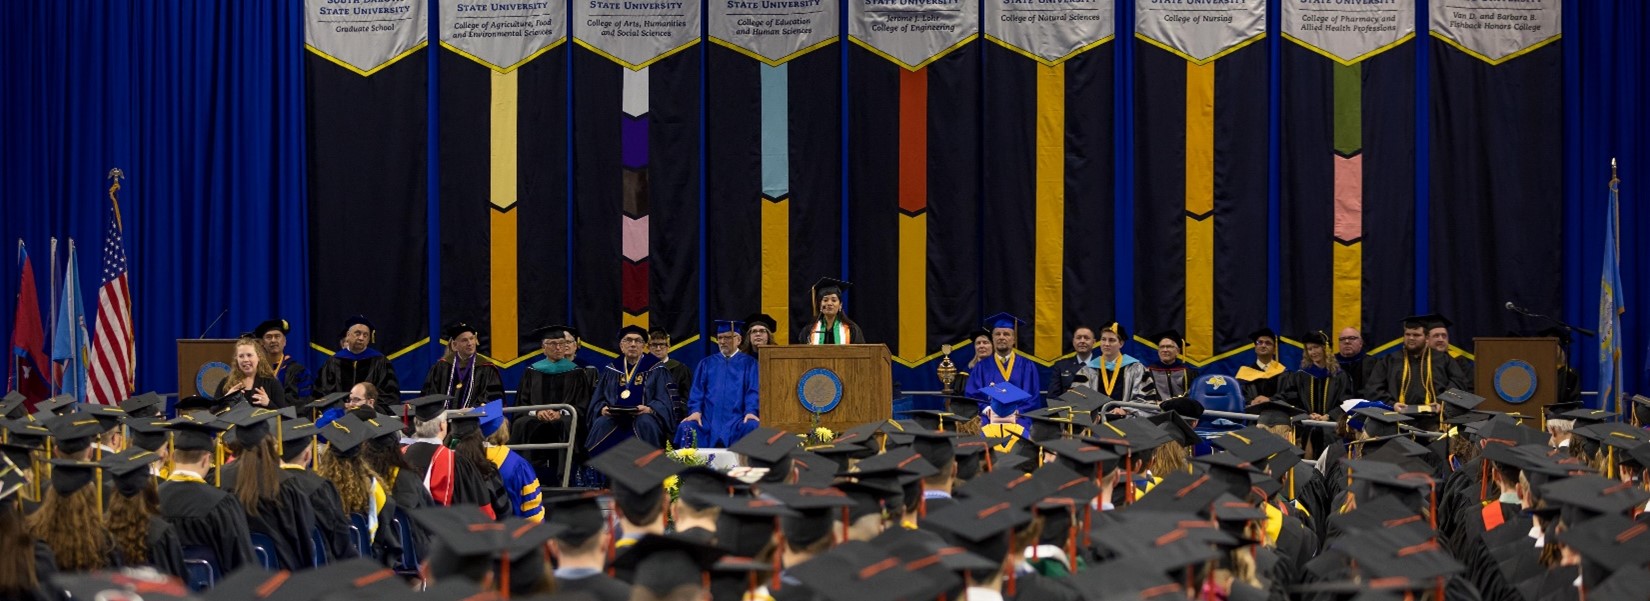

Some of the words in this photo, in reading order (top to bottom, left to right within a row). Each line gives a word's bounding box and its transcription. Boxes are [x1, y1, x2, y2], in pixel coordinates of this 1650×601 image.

[491, 2, 548, 11] UNIVERSITY
[762, 0, 819, 8] UNIVERSITY
[353, 6, 410, 14] UNIVERSITY
[1001, 15, 1026, 23] College
[1028, 15, 1036, 23] of
[1164, 15, 1191, 24] College
[1193, 15, 1200, 24] of
[1302, 15, 1328, 23] College
[1340, 16, 1378, 24] Pharmacy
[454, 22, 479, 31] College
[481, 21, 489, 30] of
[587, 20, 612, 28] College
[1514, 24, 1541, 32] College
[872, 25, 898, 33] College
[901, 24, 908, 33] of
